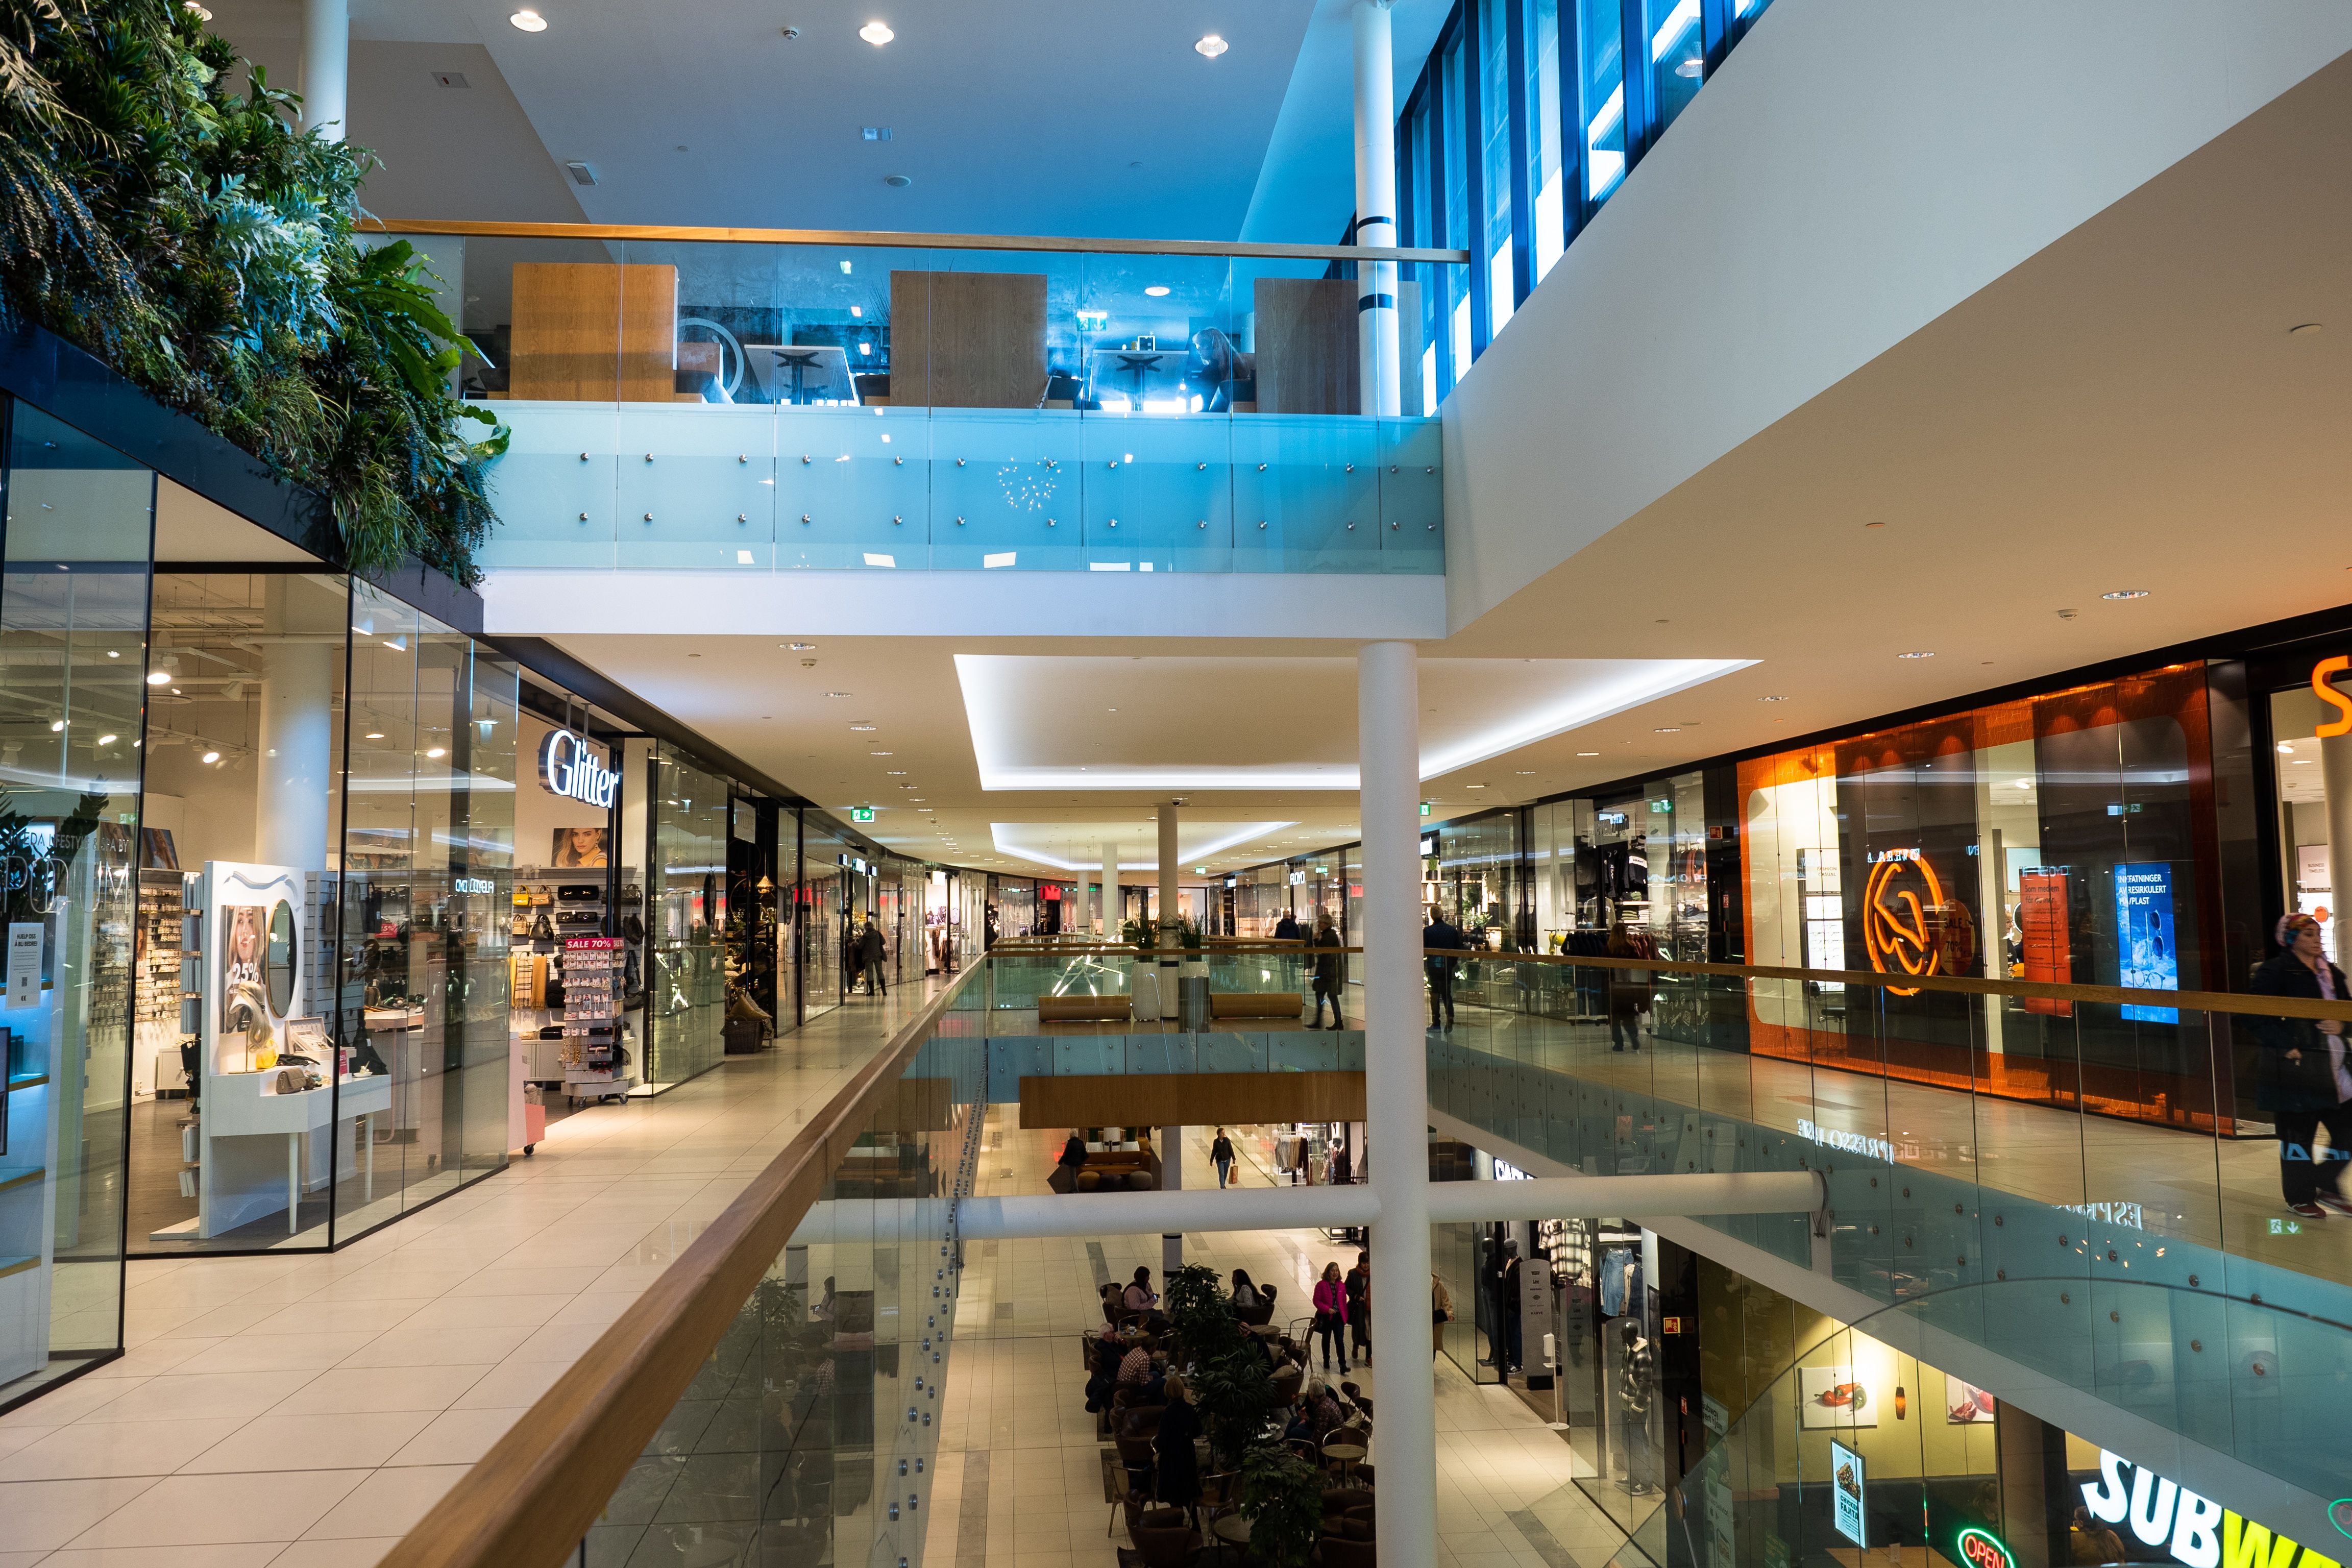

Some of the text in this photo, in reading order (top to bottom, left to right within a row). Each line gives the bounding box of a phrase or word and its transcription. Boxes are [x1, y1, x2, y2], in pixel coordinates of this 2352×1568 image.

[547, 729, 619, 808] Glitter
[118, 840, 129, 853] BY
[2025, 885, 2036, 893] Som
[2128, 885, 2167, 894] RESIRKULERT
[1944, 917, 1962, 929] SALE
[592, 940, 611, 948] 70%
[1946, 941, 1963, 952] 70%
[233, 963, 259, 984] 25%
[1840, 1494, 1858, 1509] CHICKEN
[2080, 1448, 2341, 1568] SUBW
[1840, 1501, 1858, 1521] FAJITA
[1965, 1534, 2005, 1568] OPEN
